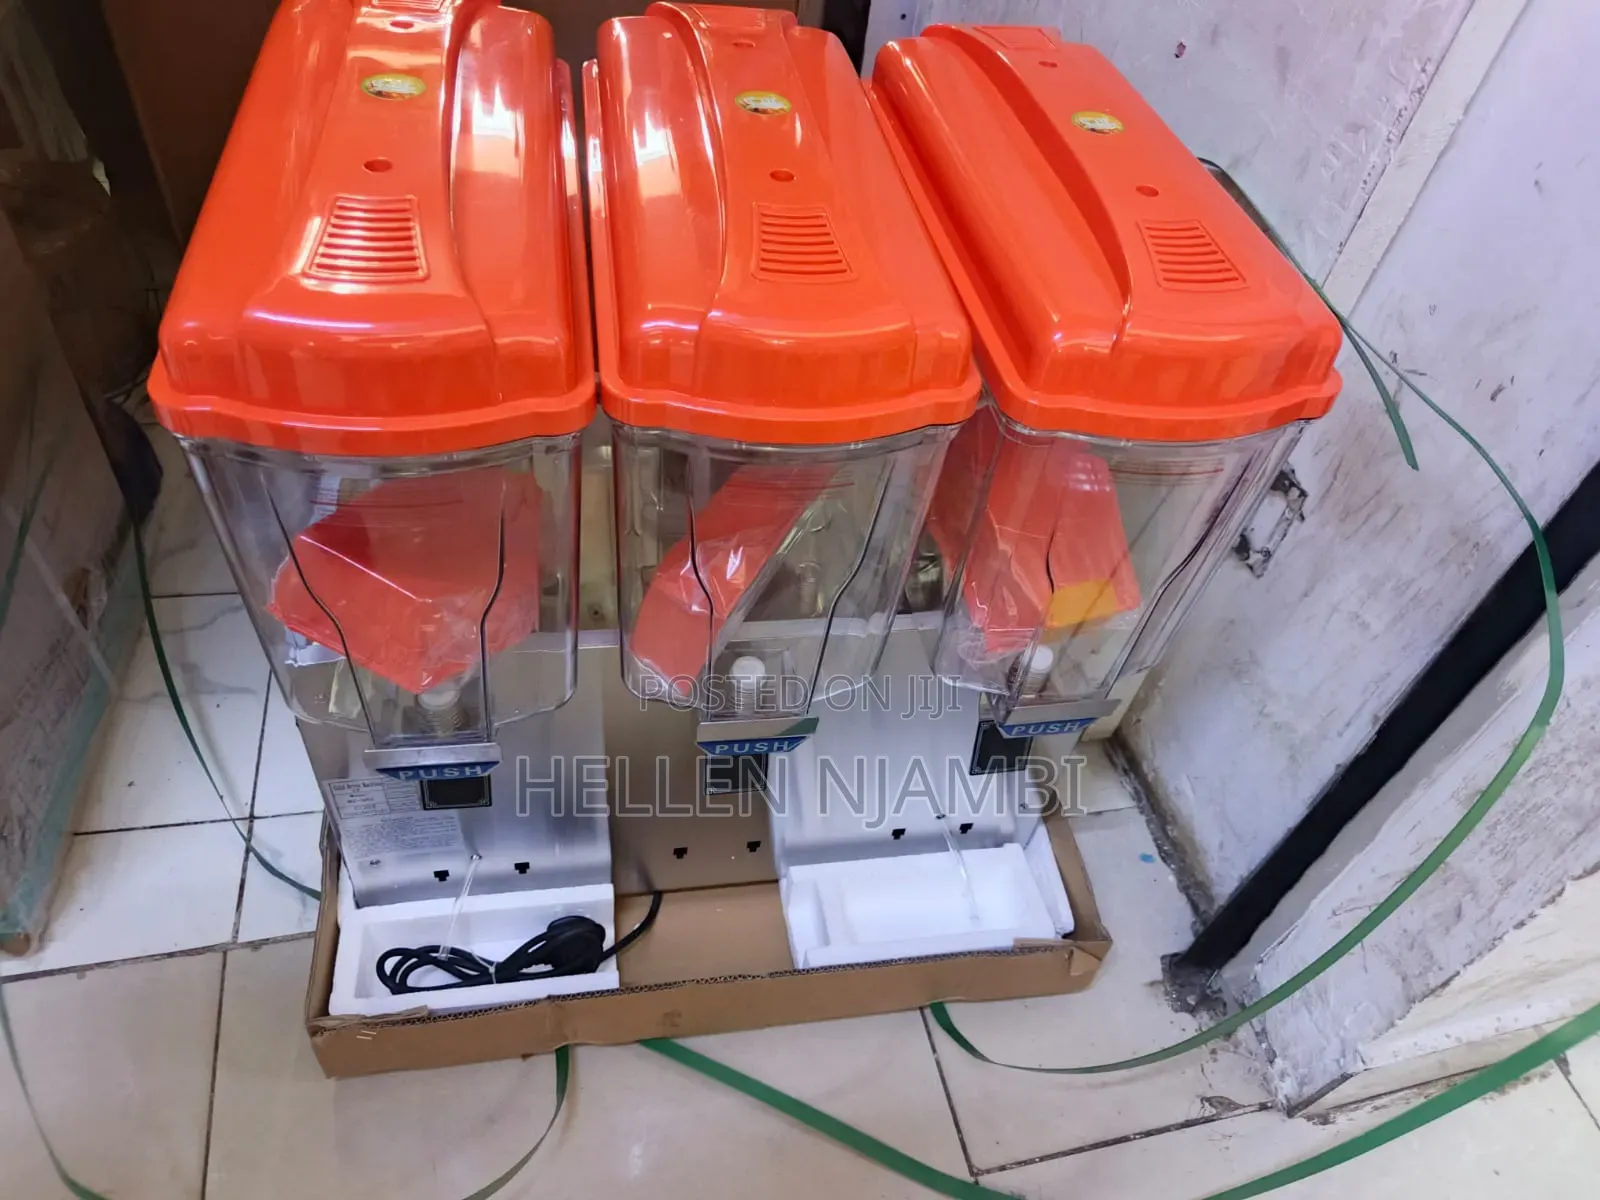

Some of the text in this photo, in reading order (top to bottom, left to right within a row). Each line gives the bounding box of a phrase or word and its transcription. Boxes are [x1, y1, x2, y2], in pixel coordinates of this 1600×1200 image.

[1011, 721, 1078, 736] PUSH
[715, 740, 789, 754] PUSH
[399, 765, 482, 780] PUSH
